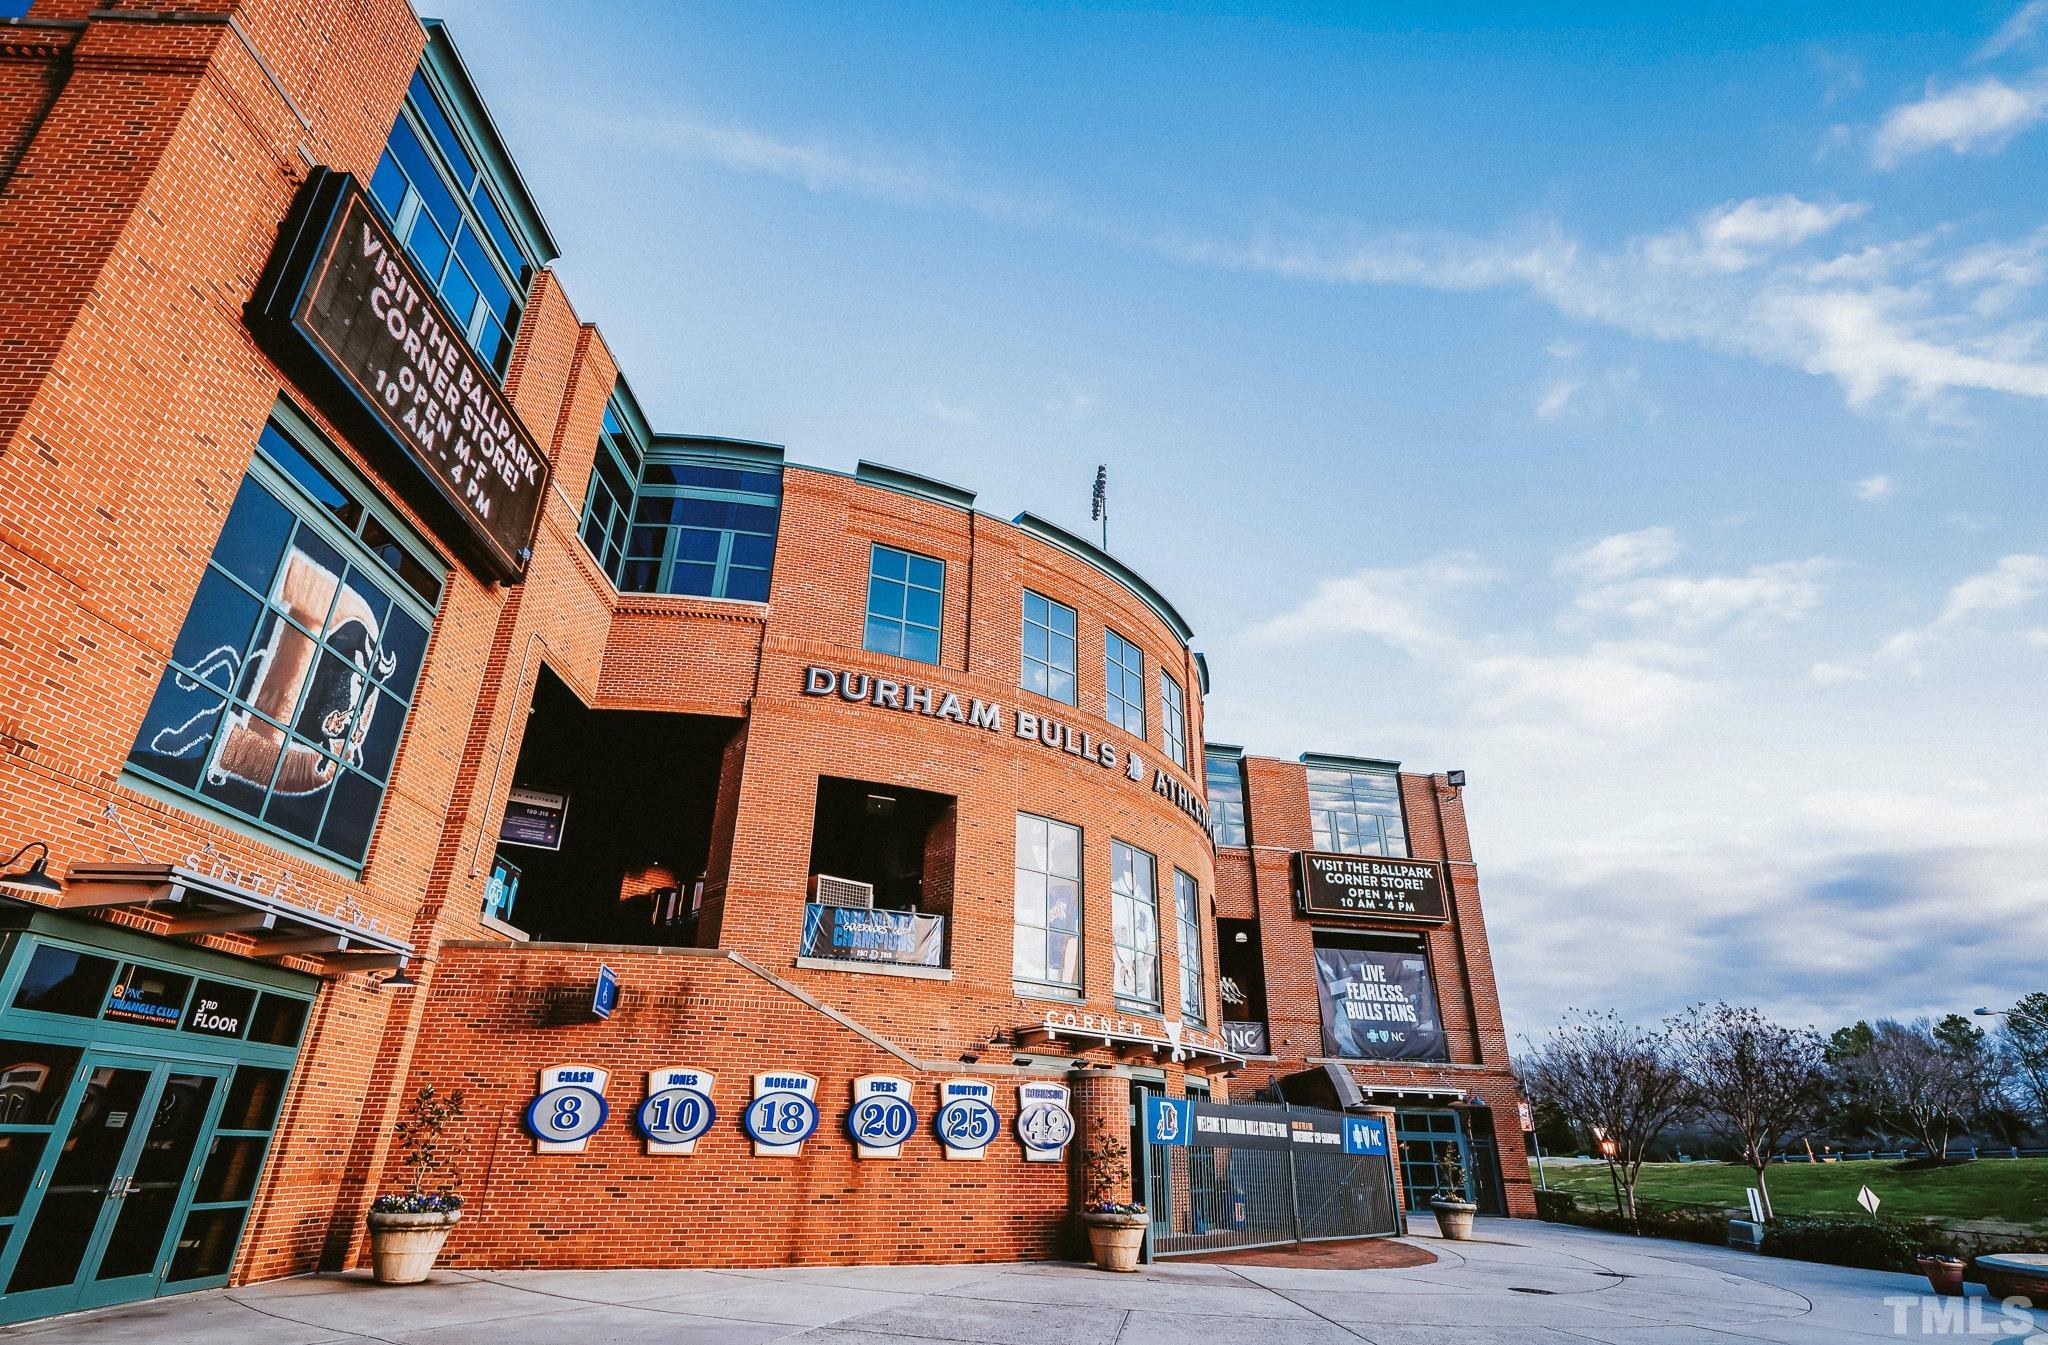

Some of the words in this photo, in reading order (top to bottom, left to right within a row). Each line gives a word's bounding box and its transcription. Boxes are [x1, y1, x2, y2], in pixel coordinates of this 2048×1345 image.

[363, 222, 419, 315] VISIT
[420, 305, 460, 375] THE
[459, 364, 540, 485] BALLPARK
[371, 287, 460, 414] CORNER
[461, 405, 519, 492] STORE!
[399, 366, 451, 441] OPEN
[454, 435, 488, 480] M-F
[376, 369, 399, 406] 10
[402, 407, 434, 450] AM
[451, 464, 463, 484] 4
[467, 478, 490, 519] PM
[805, 666, 1001, 731] DURHAM
[1016, 709, 1117, 769] BULLS
[1312, 859, 1344, 872] VISIT
[1345, 862, 1370, 874] THE
[1373, 864, 1433, 879] BALLPARK
[1326, 873, 1378, 887] CORNER
[1381, 877, 1424, 890] STORE!
[1349, 888, 1380, 899] OPEN
[1384, 891, 1405, 900] M-F
[1341, 898, 1353, 907] 10
[1358, 899, 1375, 909] AM
[1387, 901, 1394, 910] 4
[1399, 902, 1415, 912] PM
[833, 927, 916, 953] CHAMPIONS
[1361, 964, 1386, 982] LIVE
[125, 987, 144, 1000] PNC
[1346, 982, 1408, 1004] FEARLESS,
[109, 998, 156, 1015] TRIANGLE
[156, 1006, 180, 1018] CLUB
[198, 1000, 217, 1012] 3RD
[1346, 1001, 1383, 1021] BULLS
[1384, 1004, 1416, 1023] FANS
[193, 1013, 238, 1032] FLOOR
[1046, 1011, 1143, 1037] CORNER
[1231, 1030, 1257, 1048] NC
[1391, 1032, 1405, 1042] NC
[558, 1071, 594, 1083] CRASH
[668, 1073, 698, 1086] JONES
[765, 1077, 808, 1089] MORGAN
[871, 1082, 897, 1092] EVERS
[948, 1084, 988, 1095] MONTOYO
[1025, 1088, 1063, 1099] ROBINSON
[551, 1095, 584, 1131] 8
[651, 1096, 702, 1134] 10
[758, 1100, 806, 1135] 18
[861, 1103, 908, 1138] 20
[949, 1107, 989, 1139] 25
[1027, 1109, 1065, 1141] 42
[1370, 1130, 1382, 1147] NC
